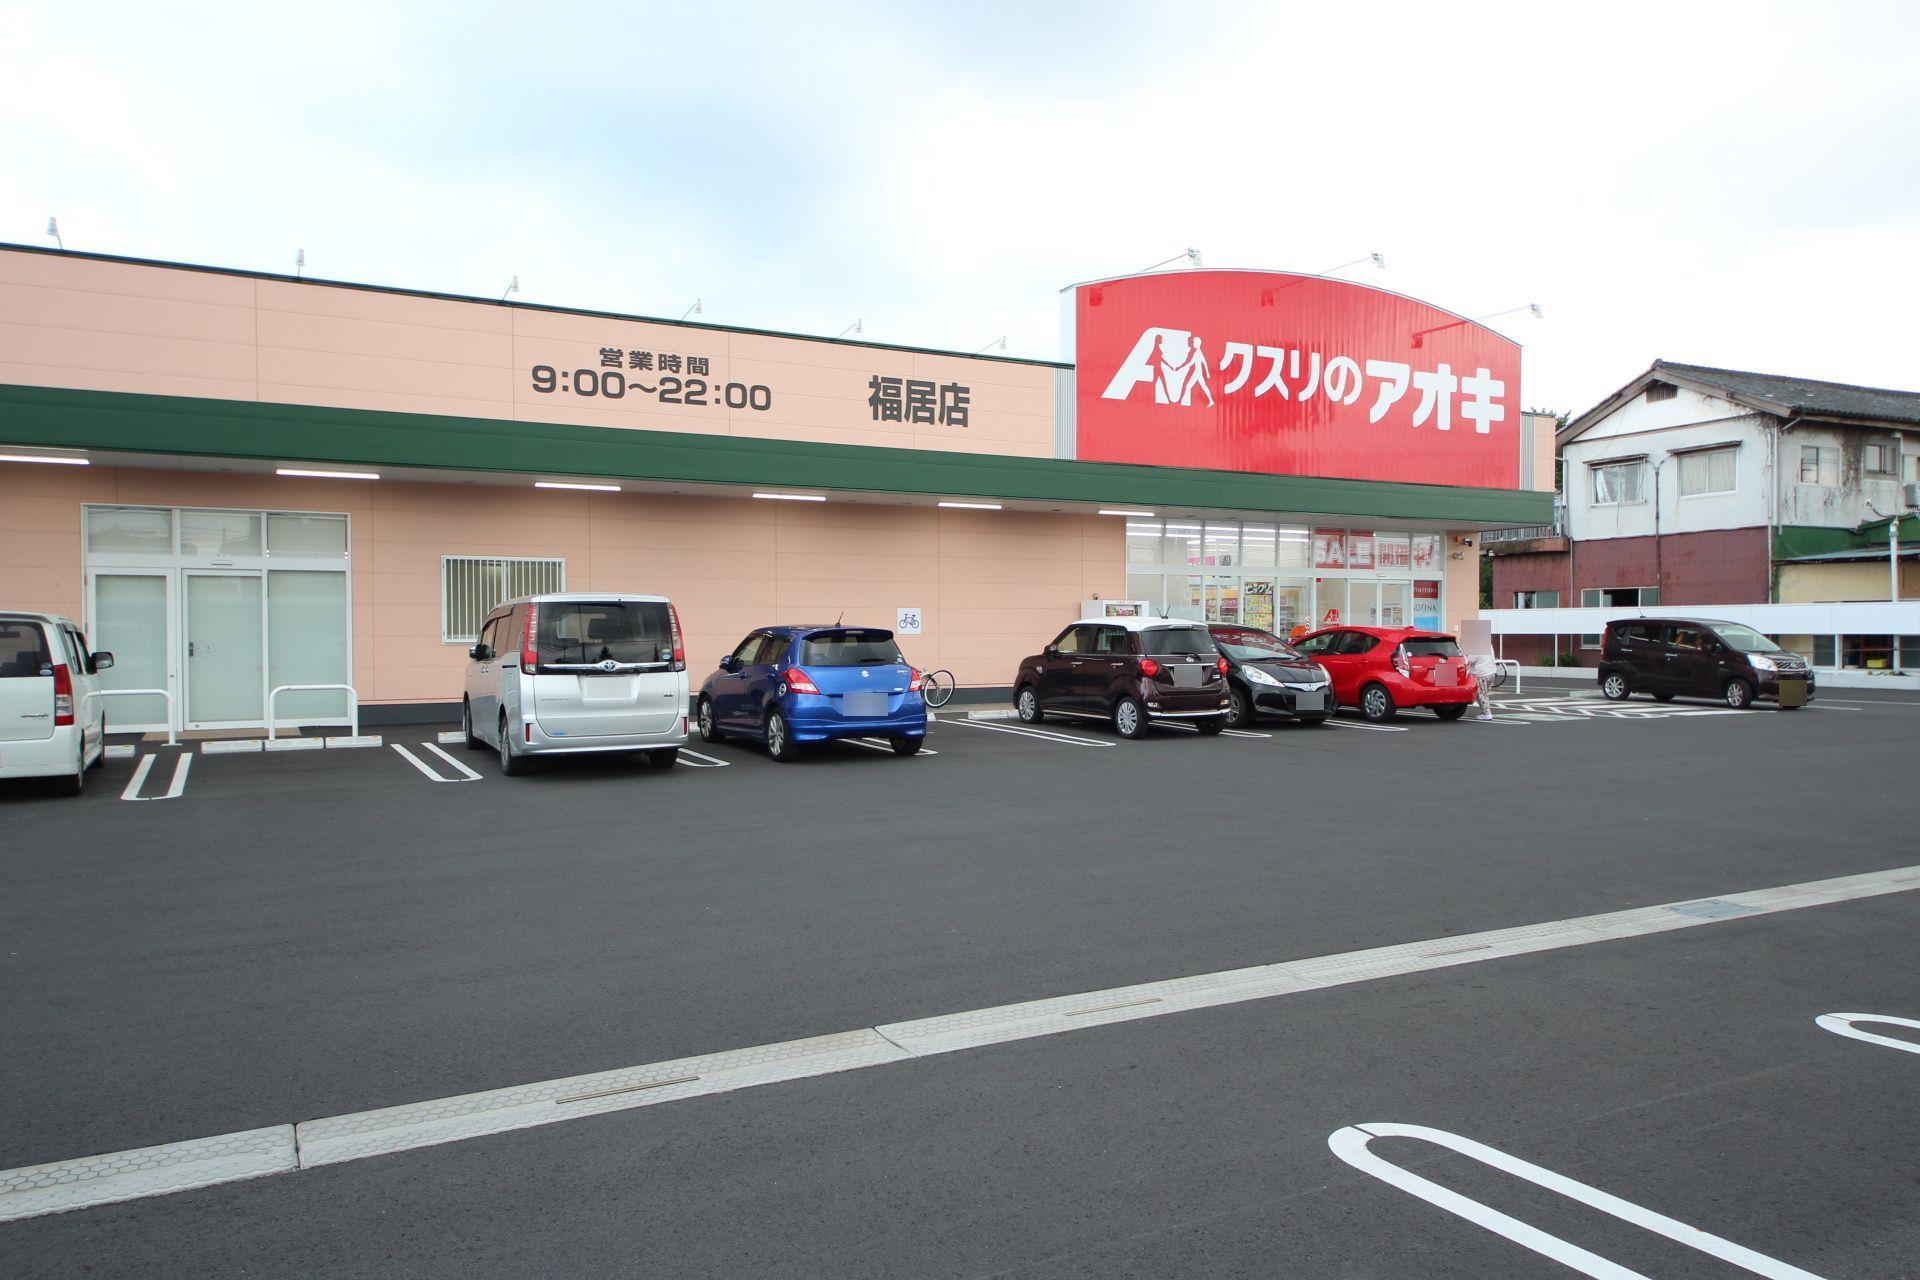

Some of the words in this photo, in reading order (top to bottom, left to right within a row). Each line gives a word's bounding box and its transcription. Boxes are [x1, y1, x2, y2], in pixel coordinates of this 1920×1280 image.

[599, 347, 711, 376] 営業時間
[868, 375, 970, 427] 福居店
[1219, 341, 1505, 434] クスリのアオキ
[1413, 603, 1438, 612] OFINA
